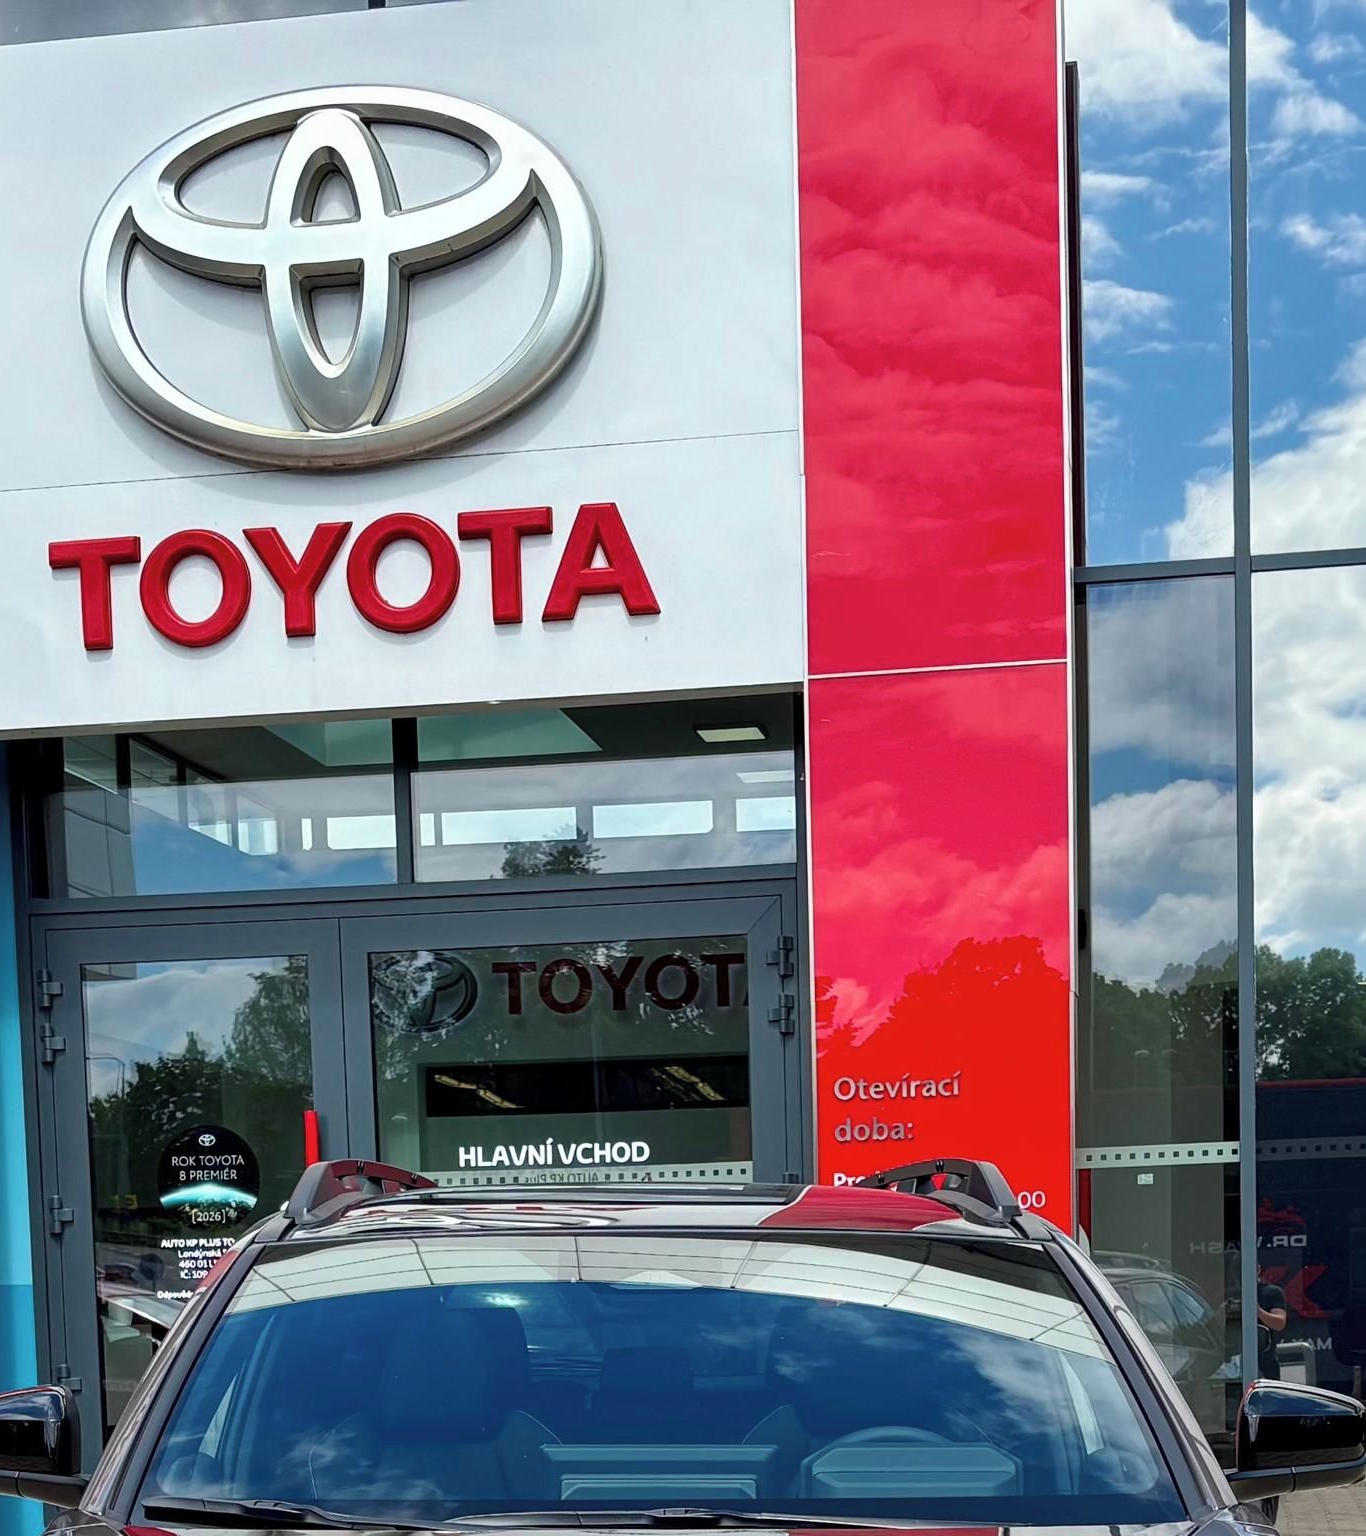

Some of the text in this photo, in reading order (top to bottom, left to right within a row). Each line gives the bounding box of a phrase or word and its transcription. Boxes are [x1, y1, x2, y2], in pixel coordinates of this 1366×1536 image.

[48, 501, 662, 652] TOYOTA
[492, 953, 749, 1015] TOYOT
[834, 1070, 963, 1101] Otevírací
[835, 1117, 914, 1143] doba:
[171, 1154, 245, 1167] ROK TOYOTA
[458, 1137, 650, 1168] HLAVNÍ VCHOD
[179, 1167, 238, 1181] 8 PREMIÉR
[192, 1209, 226, 1224] [2026]
[161, 1239, 185, 1248] AUTO
[199, 1238, 221, 1247] PLUS
